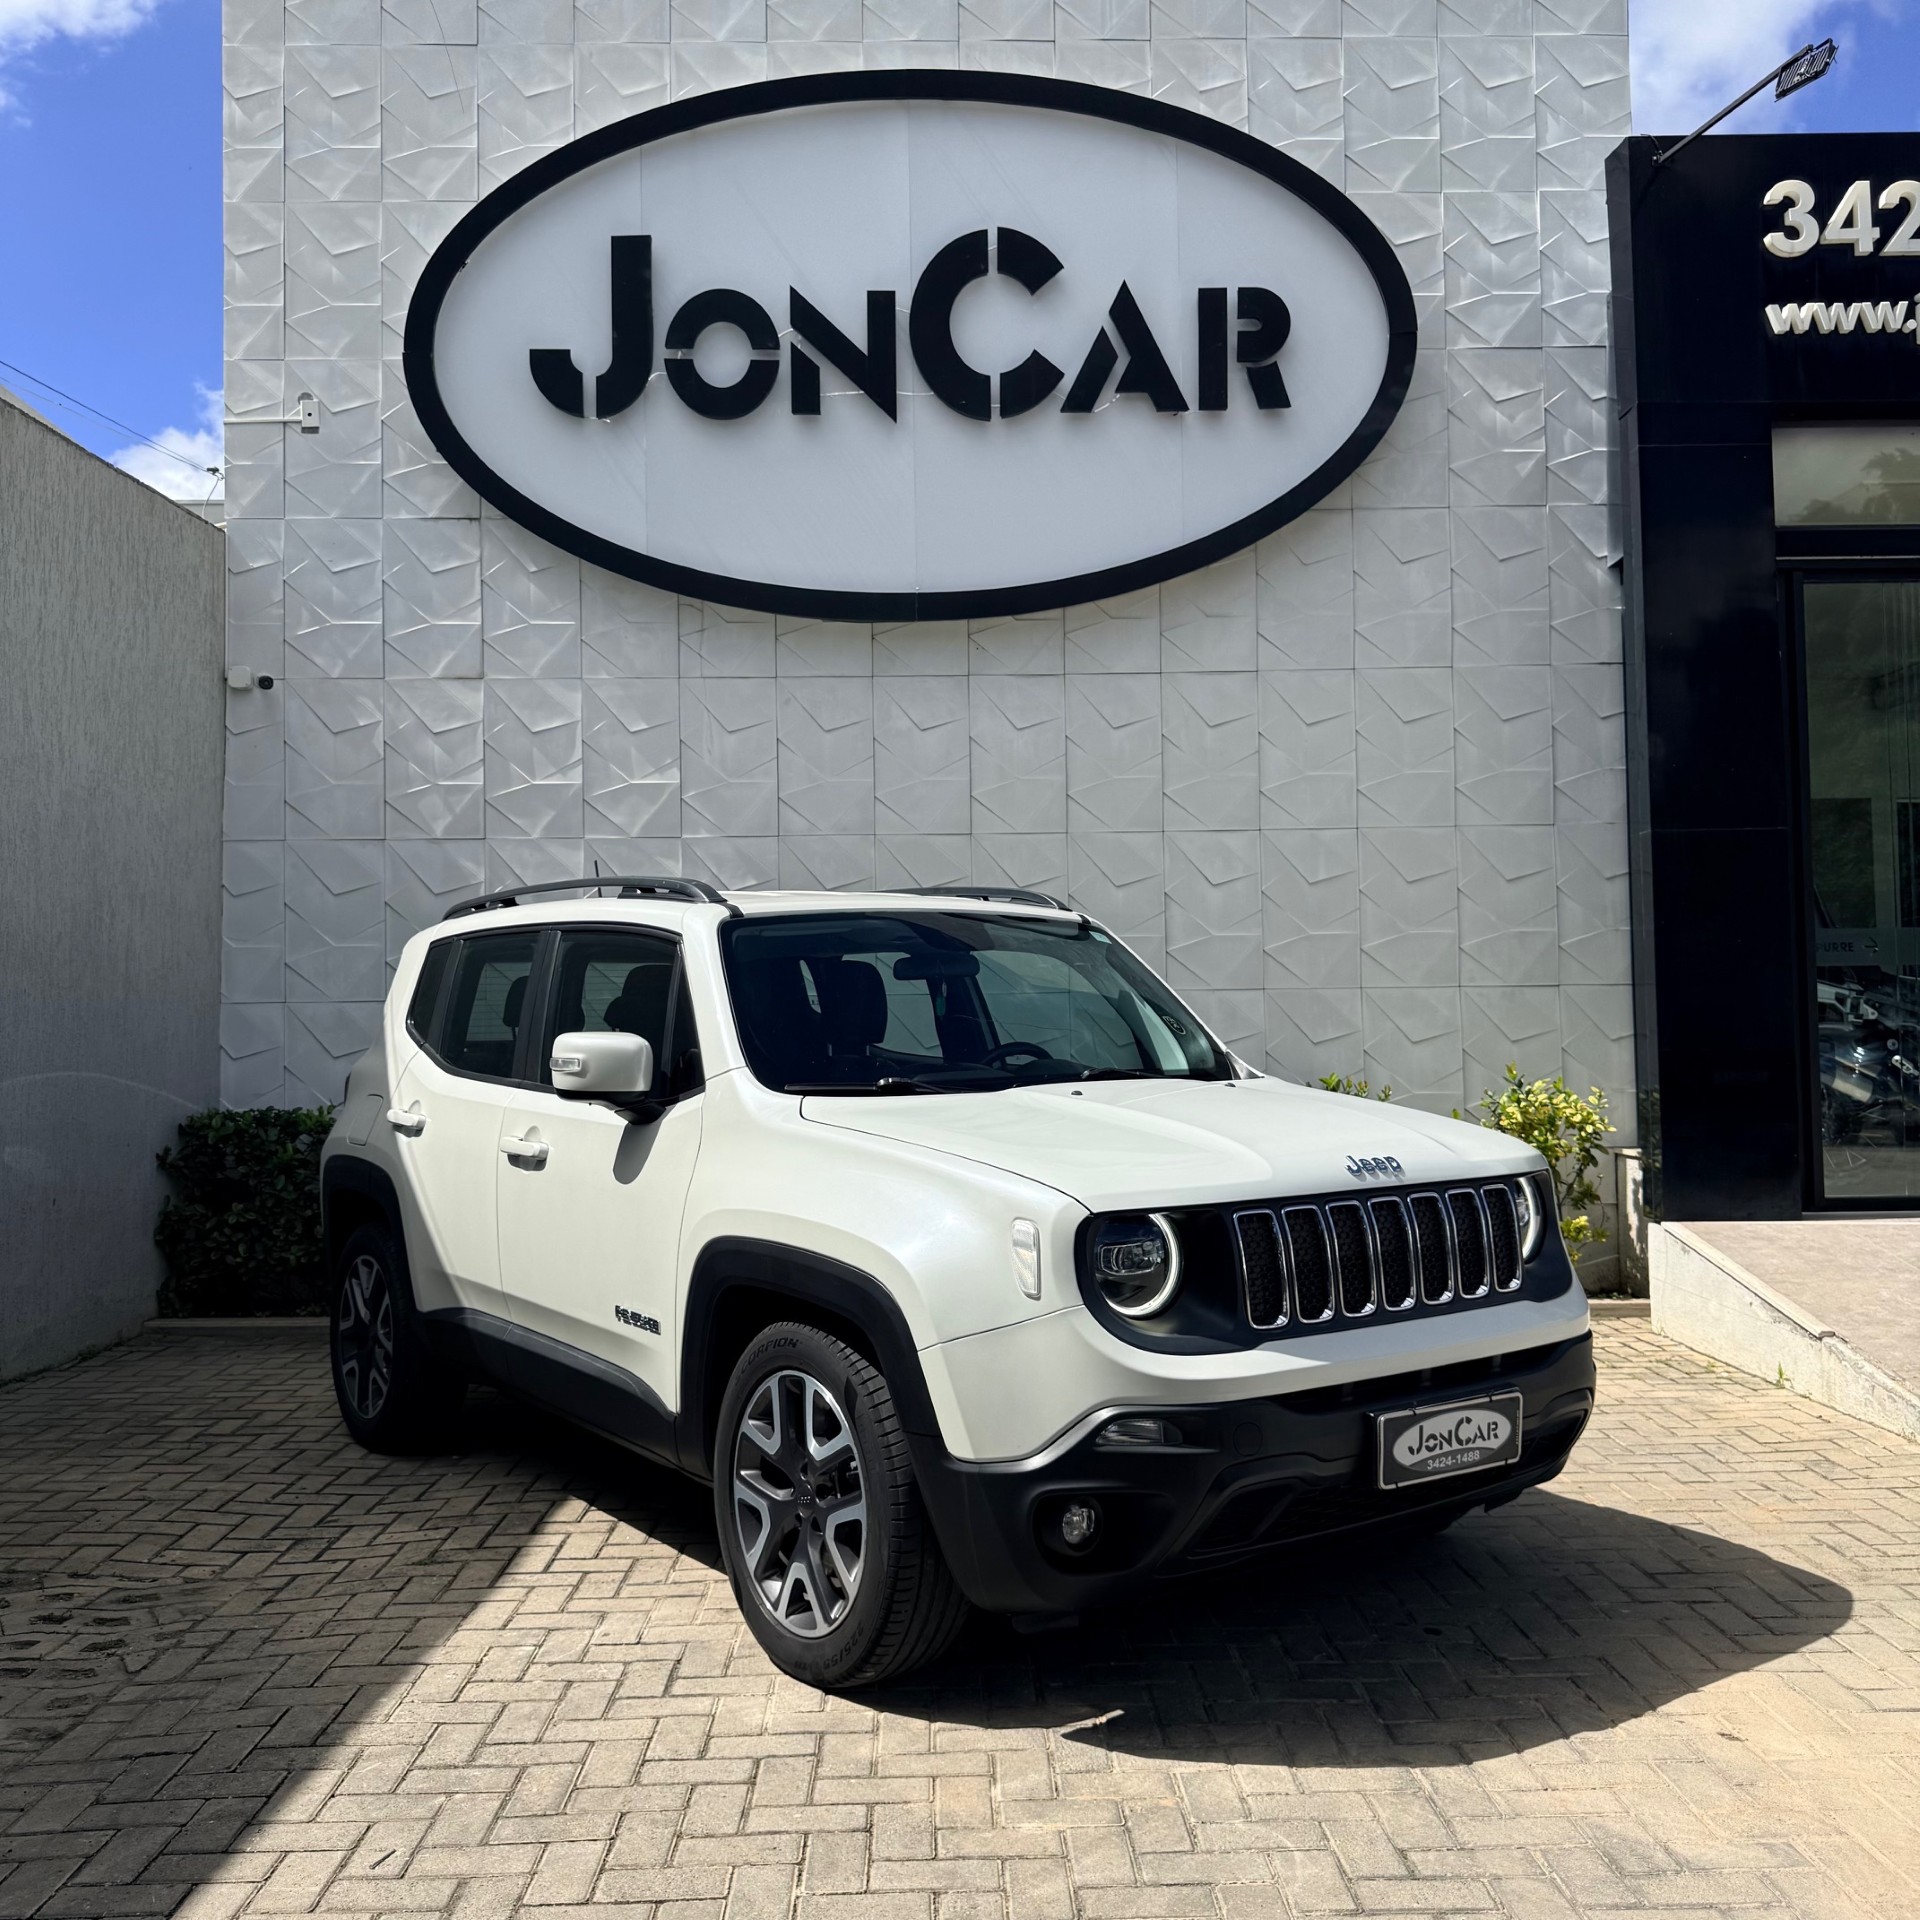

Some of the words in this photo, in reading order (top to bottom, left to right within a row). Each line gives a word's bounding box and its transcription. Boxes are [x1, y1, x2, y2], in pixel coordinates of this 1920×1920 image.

[1763, 179, 1920, 258] 342
[1343, 1155, 1402, 1178] Jeep
[1427, 1450, 1480, 1470] 3424-1488
